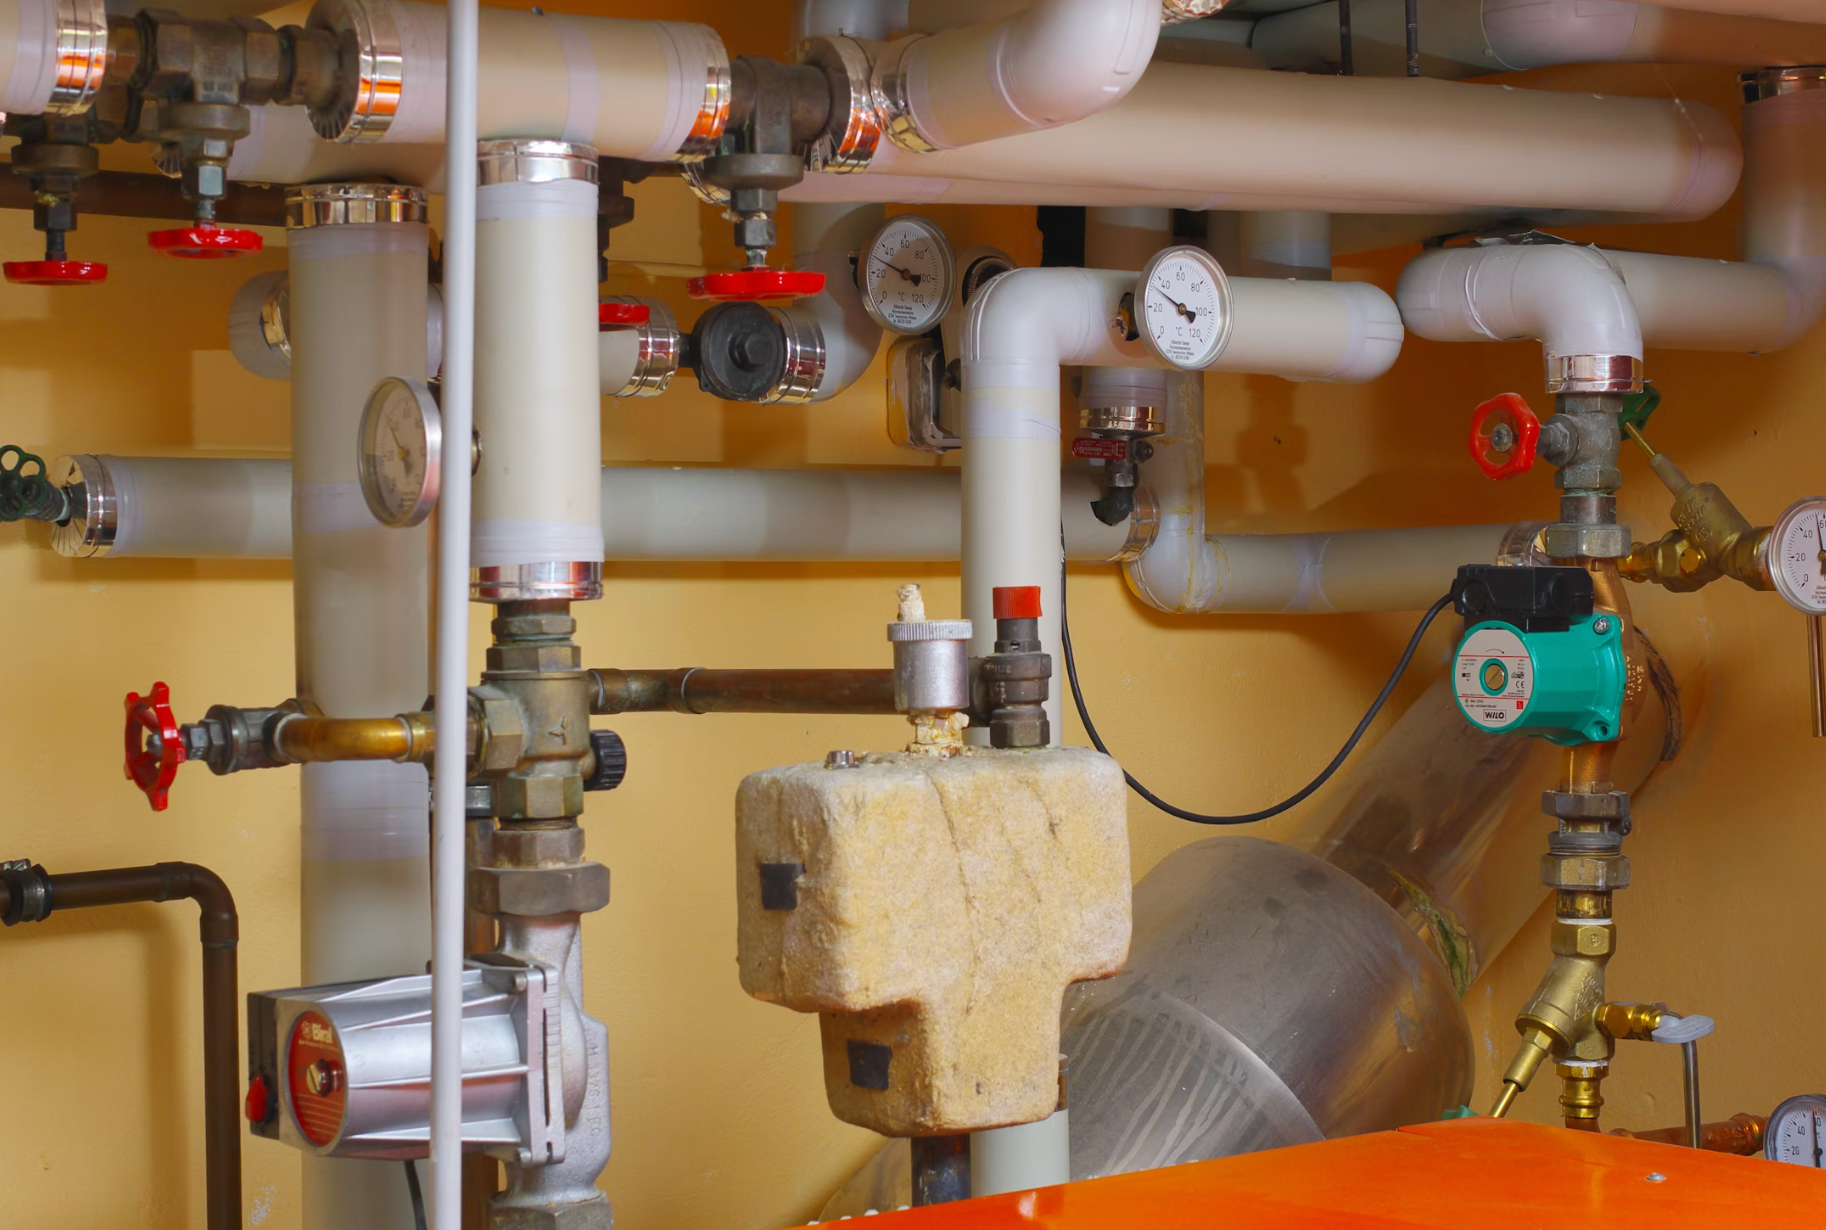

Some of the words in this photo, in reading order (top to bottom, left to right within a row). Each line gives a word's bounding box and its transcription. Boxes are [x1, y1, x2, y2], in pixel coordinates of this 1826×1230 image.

[900, 239, 909, 248] 60
[885, 248, 894, 256] 40
[914, 250, 924, 260] 80
[876, 269, 886, 278] 20
[1176, 272, 1185, 281] 60
[1161, 280, 1170, 290] 40
[1191, 283, 1200, 292] 80
[882, 291, 887, 300] 0
[912, 294, 923, 303] 120
[1154, 303, 1162, 312] 20
[1196, 307, 1207, 317] 100
[1160, 325, 1164, 335] 0
[1176, 326, 1182, 336] °C
[1189, 328, 1201, 338] 120
[1803, 530, 1813, 538] 40
[1796, 553, 1806, 561] 20
[1804, 574, 1808, 582] 0
[1485, 711, 1504, 720] WILO
[1798, 1126, 1805, 1135] 40
[1791, 1146, 1800, 1155] 20
